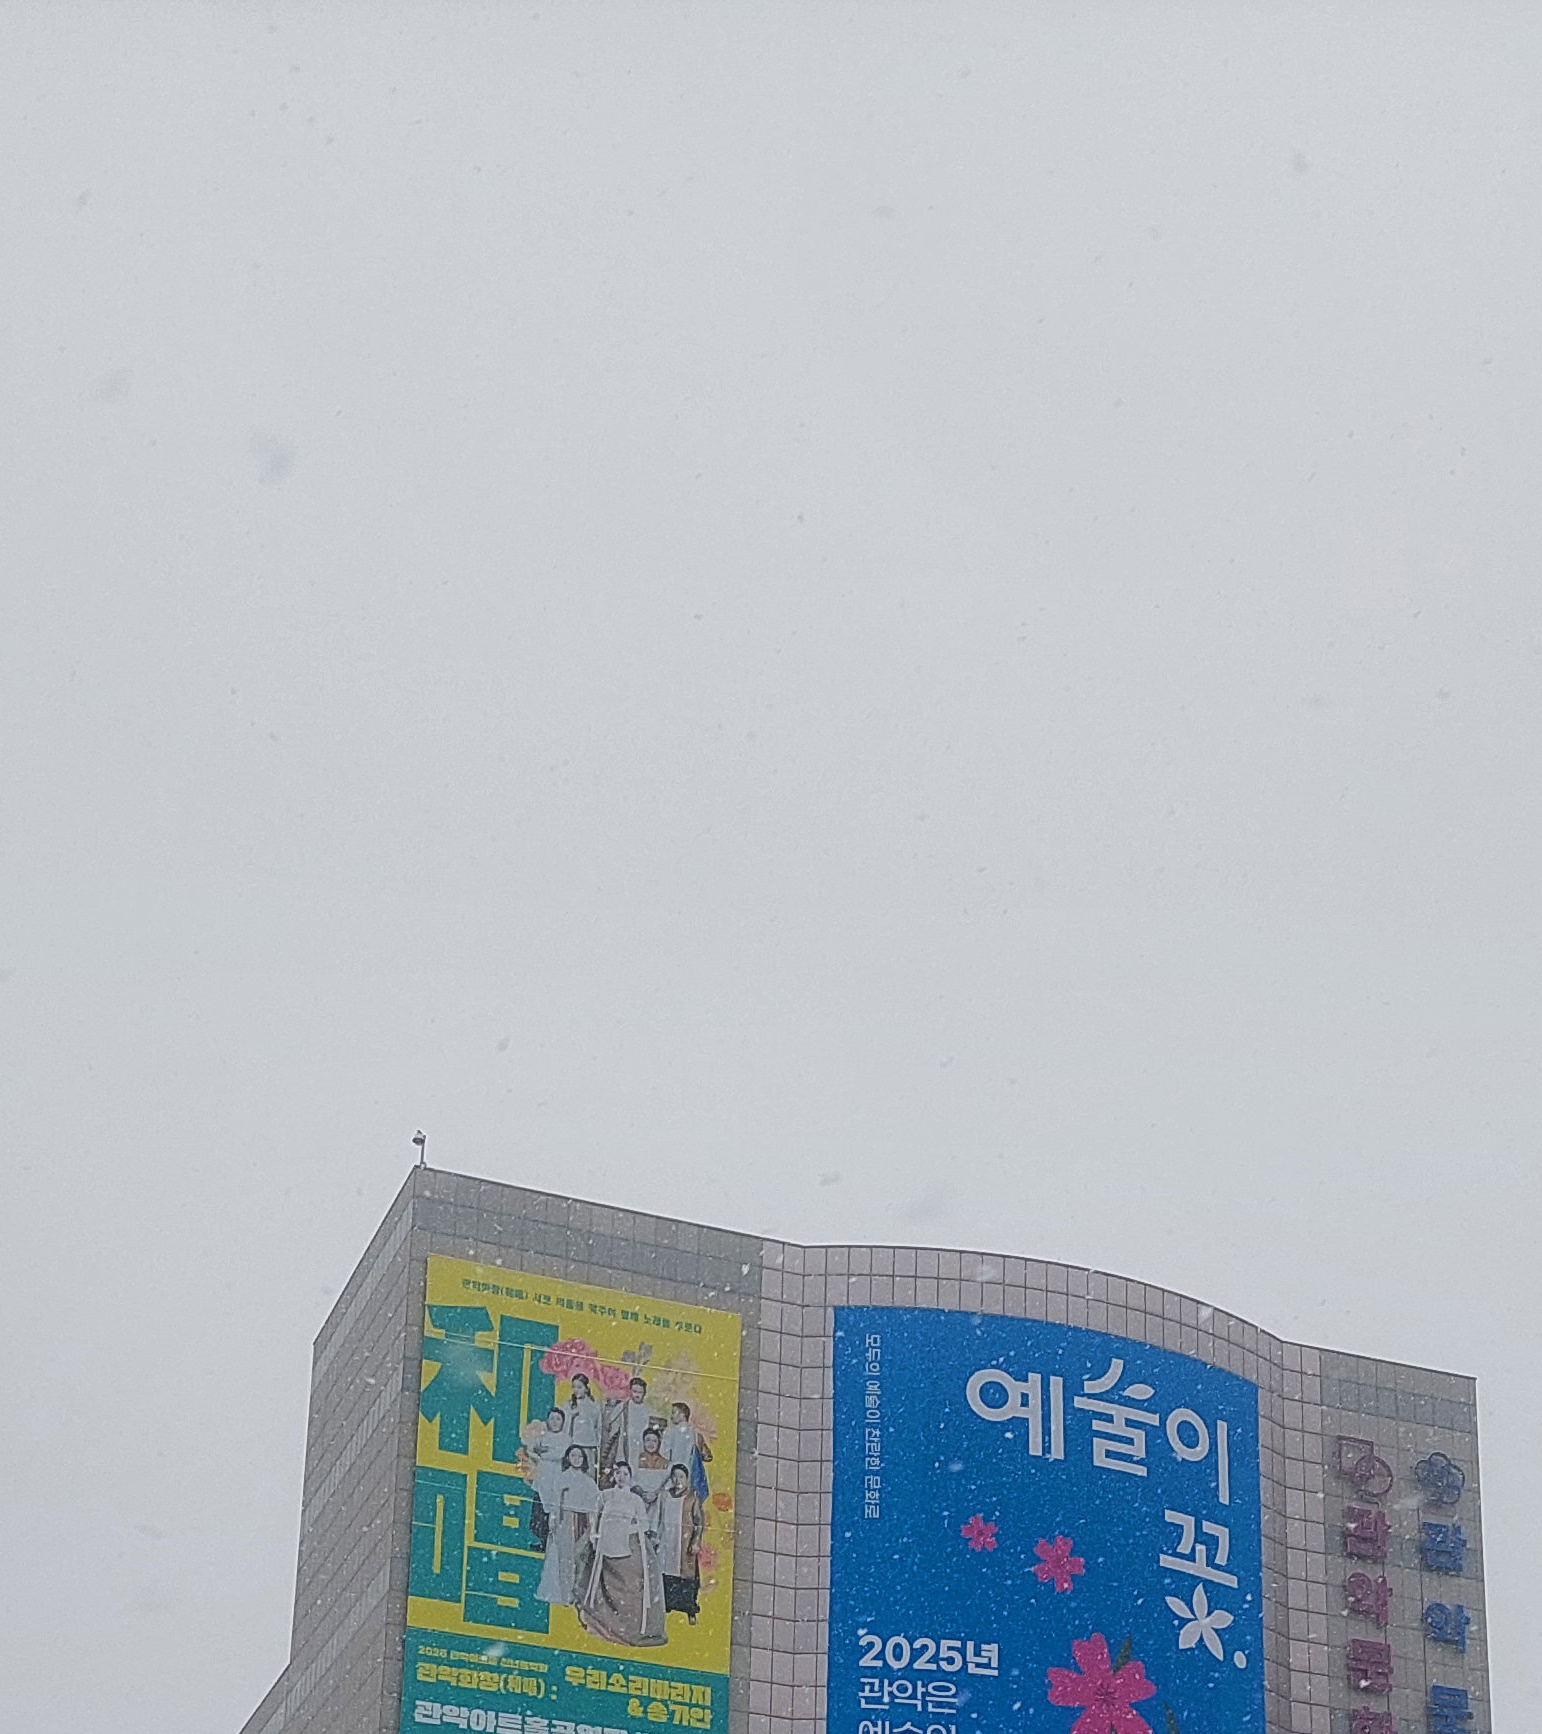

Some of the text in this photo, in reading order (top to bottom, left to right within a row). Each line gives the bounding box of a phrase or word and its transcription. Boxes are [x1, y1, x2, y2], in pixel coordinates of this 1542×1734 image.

[865, 1333, 881, 1519] 모두의 예술이 찬란한 문화로
[965, 1358, 1230, 1505] 예술이
[858, 1634, 1000, 1677] 2025년
[564, 1665, 712, 1706] 우리소리바라지
[858, 1679, 958, 1714] 관악은
[627, 1697, 711, 1730] & 송가인
